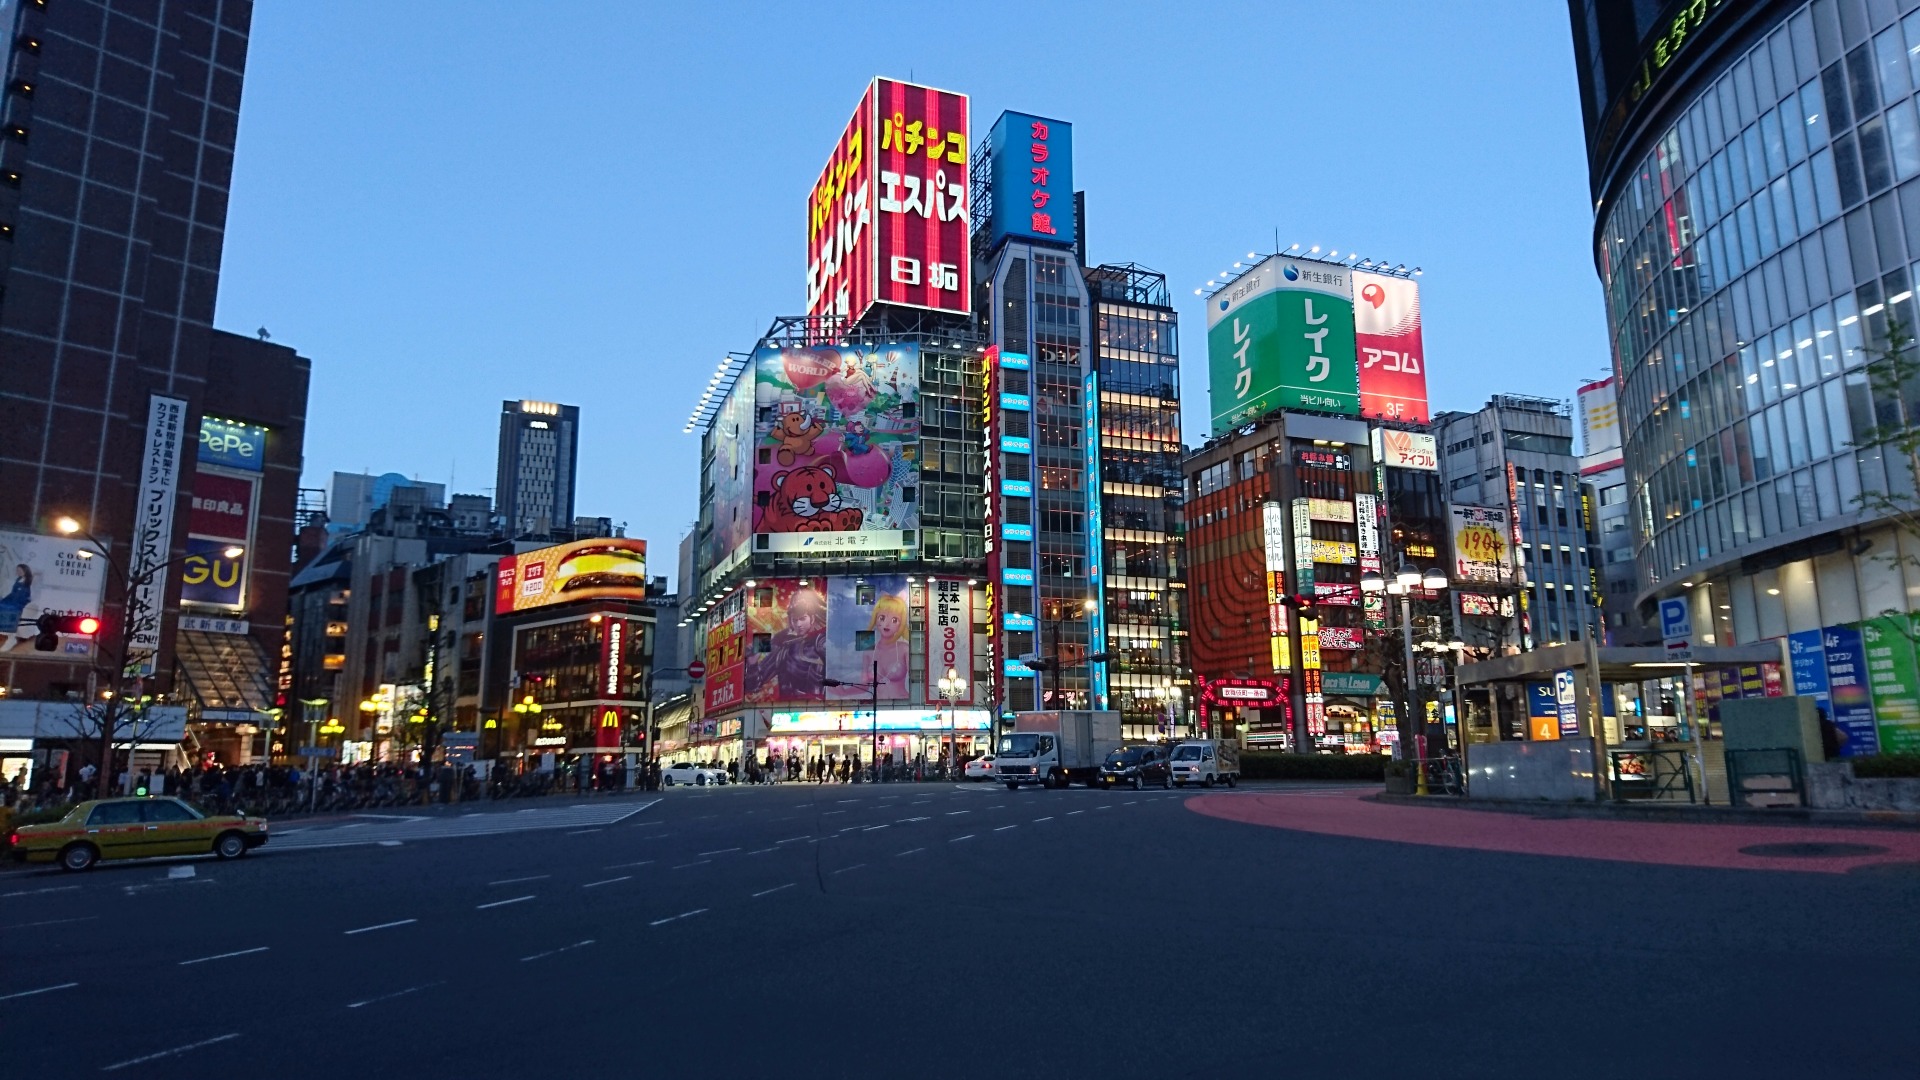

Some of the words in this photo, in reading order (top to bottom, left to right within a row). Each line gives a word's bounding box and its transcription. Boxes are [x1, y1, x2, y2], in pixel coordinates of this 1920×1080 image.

[882, 112, 966, 164] パチンコ
[811, 126, 862, 243] パチンコ
[880, 169, 967, 223] エスパス
[807, 178, 871, 315] エスパス
[1231, 274, 1262, 302] 新生銀行
[1301, 269, 1343, 287] 新生銀行
[1303, 298, 1331, 382] レイク
[789, 363, 828, 377] WORLD
[1233, 317, 1252, 399] レイク
[1362, 347, 1421, 375] アコム
[983, 355, 991, 423] パチンコ
[1300, 394, 1341, 408] 当ビル向い
[1386, 403, 1404, 416] 3F
[149, 402, 167, 484] カフェ&レストラン
[984, 426, 992, 518] エスパス
[1398, 452, 1435, 467] アイフル
[835, 535, 869, 546] 北電子
[1271, 513, 1282, 561] 小松ビル
[55, 559, 92, 569] GENERAL
[60, 568, 86, 577] STORE
[183, 555, 240, 588] GU
[525, 581, 543, 592] ¥200
[938, 580, 949, 627] 超大型店
[949, 581, 960, 624] 日本一の
[986, 582, 994, 637] パチンコ
[1661, 600, 1686, 636] P
[1318, 628, 1351, 639] ゃぶしゃぶ
[1791, 640, 1804, 655] 3F
[1825, 632, 1839, 648] 4F
[607, 622, 621, 695] McDonald's
[1828, 652, 1852, 662] エアコン
[712, 681, 735, 707] エスパス
[1558, 677, 1567, 702] P
[1540, 722, 1552, 740] 4
